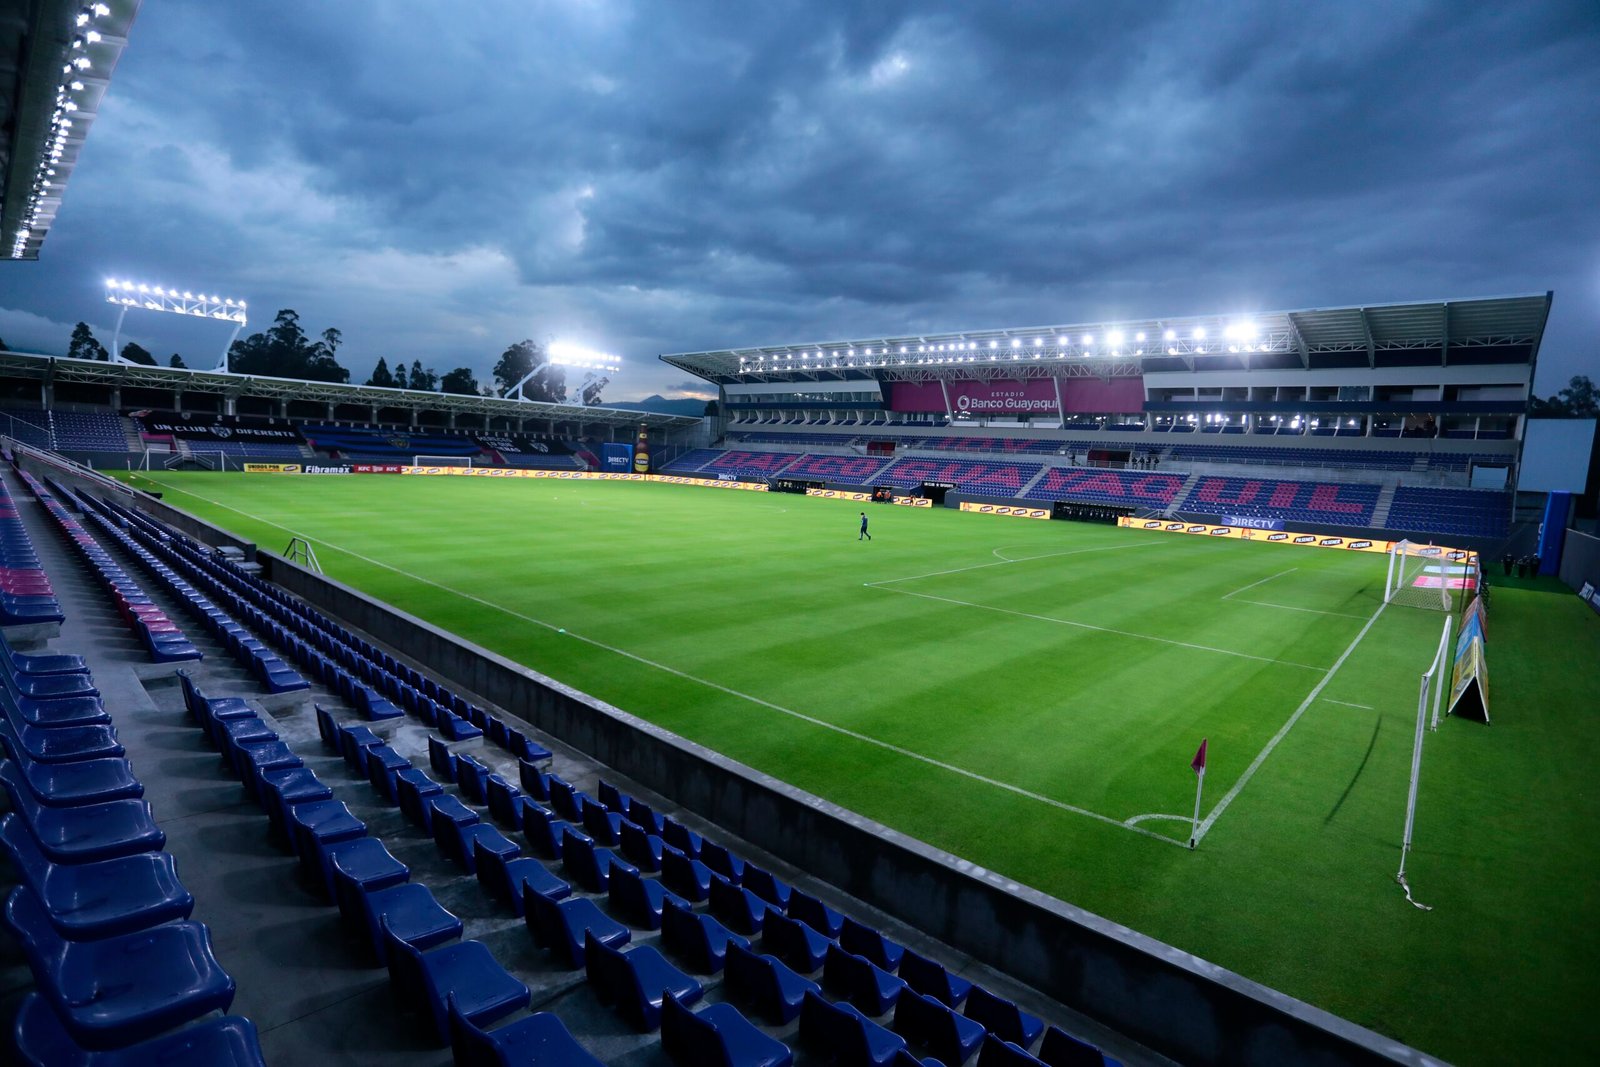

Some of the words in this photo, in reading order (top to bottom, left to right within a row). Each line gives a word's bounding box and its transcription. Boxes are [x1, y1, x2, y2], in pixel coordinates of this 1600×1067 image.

[971, 398, 1004, 409] Banco
[1005, 397, 1062, 411] Guayaqui
[153, 423, 172, 431] UN
[174, 425, 207, 433] CLUB
[236, 428, 296, 438] DIFERENTE
[305, 465, 351, 474] Fibramax
[1230, 517, 1275, 529] DIRECTV
[1321, 538, 1342, 546] PILSENER
[1350, 541, 1371, 549] PILSENER
